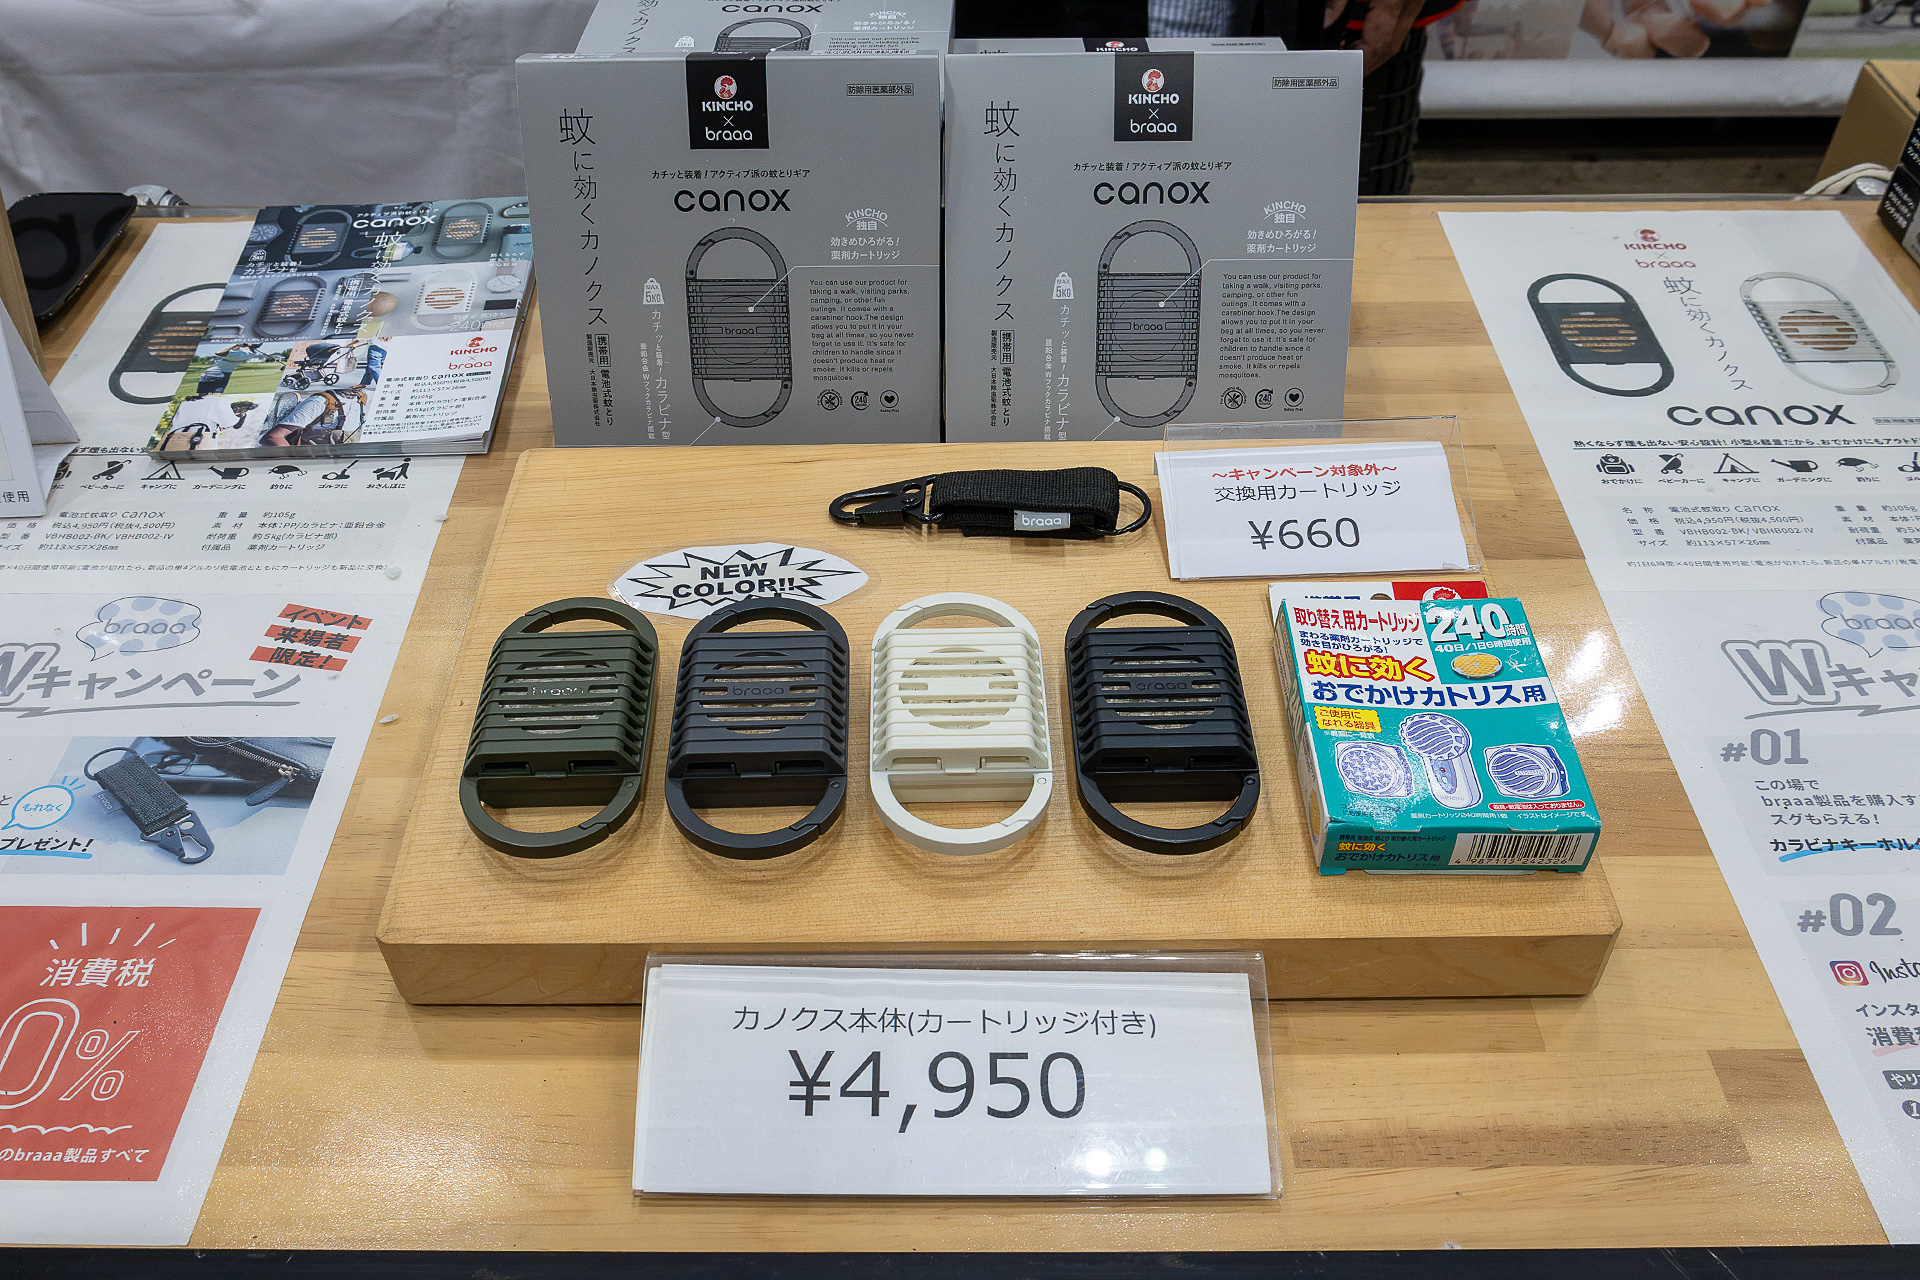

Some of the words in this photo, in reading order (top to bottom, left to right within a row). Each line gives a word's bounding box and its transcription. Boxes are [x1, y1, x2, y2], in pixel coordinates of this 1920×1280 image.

[722, 4, 823, 13] canox
[1274, 78, 1338, 88] 防除用医薬部外品
[702, 100, 753, 112] KINCHO
[1128, 94, 1180, 104] KINCHO
[1130, 119, 1178, 133] braaa
[705, 127, 753, 141] braaa
[1093, 181, 1211, 205] canox
[673, 189, 791, 213] canox
[1263, 200, 1307, 215] KINCHO
[559, 107, 608, 326] 蚊に効くカノクス
[845, 208, 888, 222] KINCHO
[984, 100, 1020, 321] 蚊に効くカノクス
[1274, 213, 1296, 223] 独自
[352, 214, 436, 229] canox
[856, 220, 878, 231] 独自
[830, 250, 900, 261] 薬剤カートリッジ
[1246, 243, 1317, 254] 薬剤カートリッジ
[1635, 259, 1697, 268] braaa
[645, 291, 661, 303] 5KG
[1055, 286, 1072, 298] 5KG
[723, 325, 755, 336] braaa
[1132, 322, 1164, 331] braaa
[1663, 276, 1753, 391] 蚊に効くカノクス
[450, 346, 498, 356] KINCHO
[1002, 332, 1012, 363] 携帯用
[448, 361, 493, 371] braaa
[1002, 366, 1012, 427] 電池式蚊とり
[1667, 405, 1857, 426] canox
[1214, 480, 1401, 503] 交換用カートリッジ
[121, 511, 166, 519] canox
[1021, 514, 1062, 527] braaa
[1248, 517, 1360, 550] ¥660
[700, 563, 768, 580] NEW
[672, 577, 795, 598] COLOR!!
[282, 604, 366, 631] イベント
[1294, 607, 1421, 633] 取り替え用カートリッジ
[102, 617, 187, 635] braaa
[276, 626, 349, 650] 来場者
[1299, 631, 1423, 647] まわる薬剤カートリッジで
[1305, 649, 1436, 682] 蚊に効く
[732, 685, 785, 696] braaa
[1311, 681, 1547, 707] おでかけカトリス用
[1319, 709, 1362, 721] ご使用に
[1720, 728, 1809, 765] #01
[1755, 779, 1820, 791] この場で
[22, 803, 64, 811] もれなく
[1337, 842, 1387, 852] 蚊に効く
[1797, 892, 1903, 936] #02
[40, 957, 156, 987] 消費税
[733, 1006, 1157, 1037] カノクス本体(カートリッジ付き)
[787, 1049, 1087, 1134] ¥4,950
